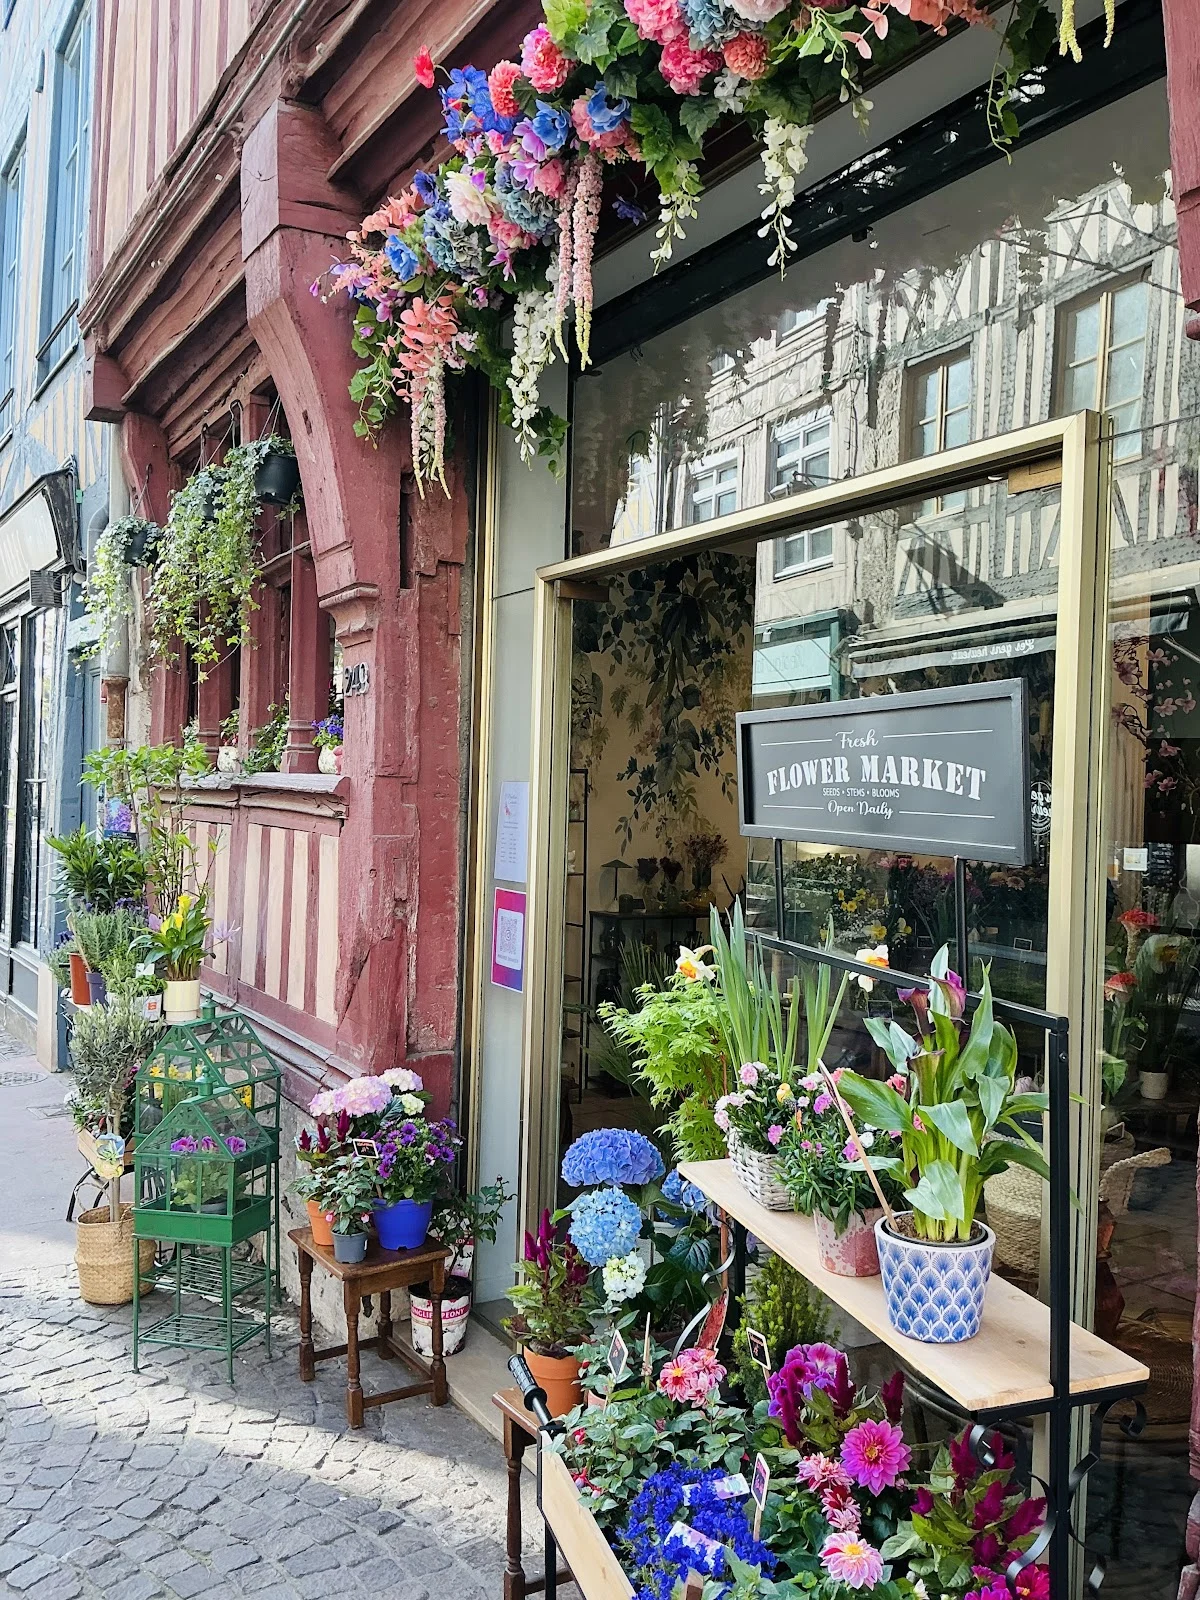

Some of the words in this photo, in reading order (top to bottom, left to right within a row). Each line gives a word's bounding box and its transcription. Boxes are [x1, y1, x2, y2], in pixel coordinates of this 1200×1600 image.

[835, 729, 879, 750] Fresh
[766, 755, 851, 796] FLOWER
[860, 755, 987, 801] MARKET
[822, 788, 840, 797] SEEDS
[846, 788, 866, 797] STEMS
[871, 788, 900, 798] BLOOMS
[828, 801, 854, 817] Open
[856, 801, 894, 820] Daily
[441, 1307, 465, 1319] PEONY
